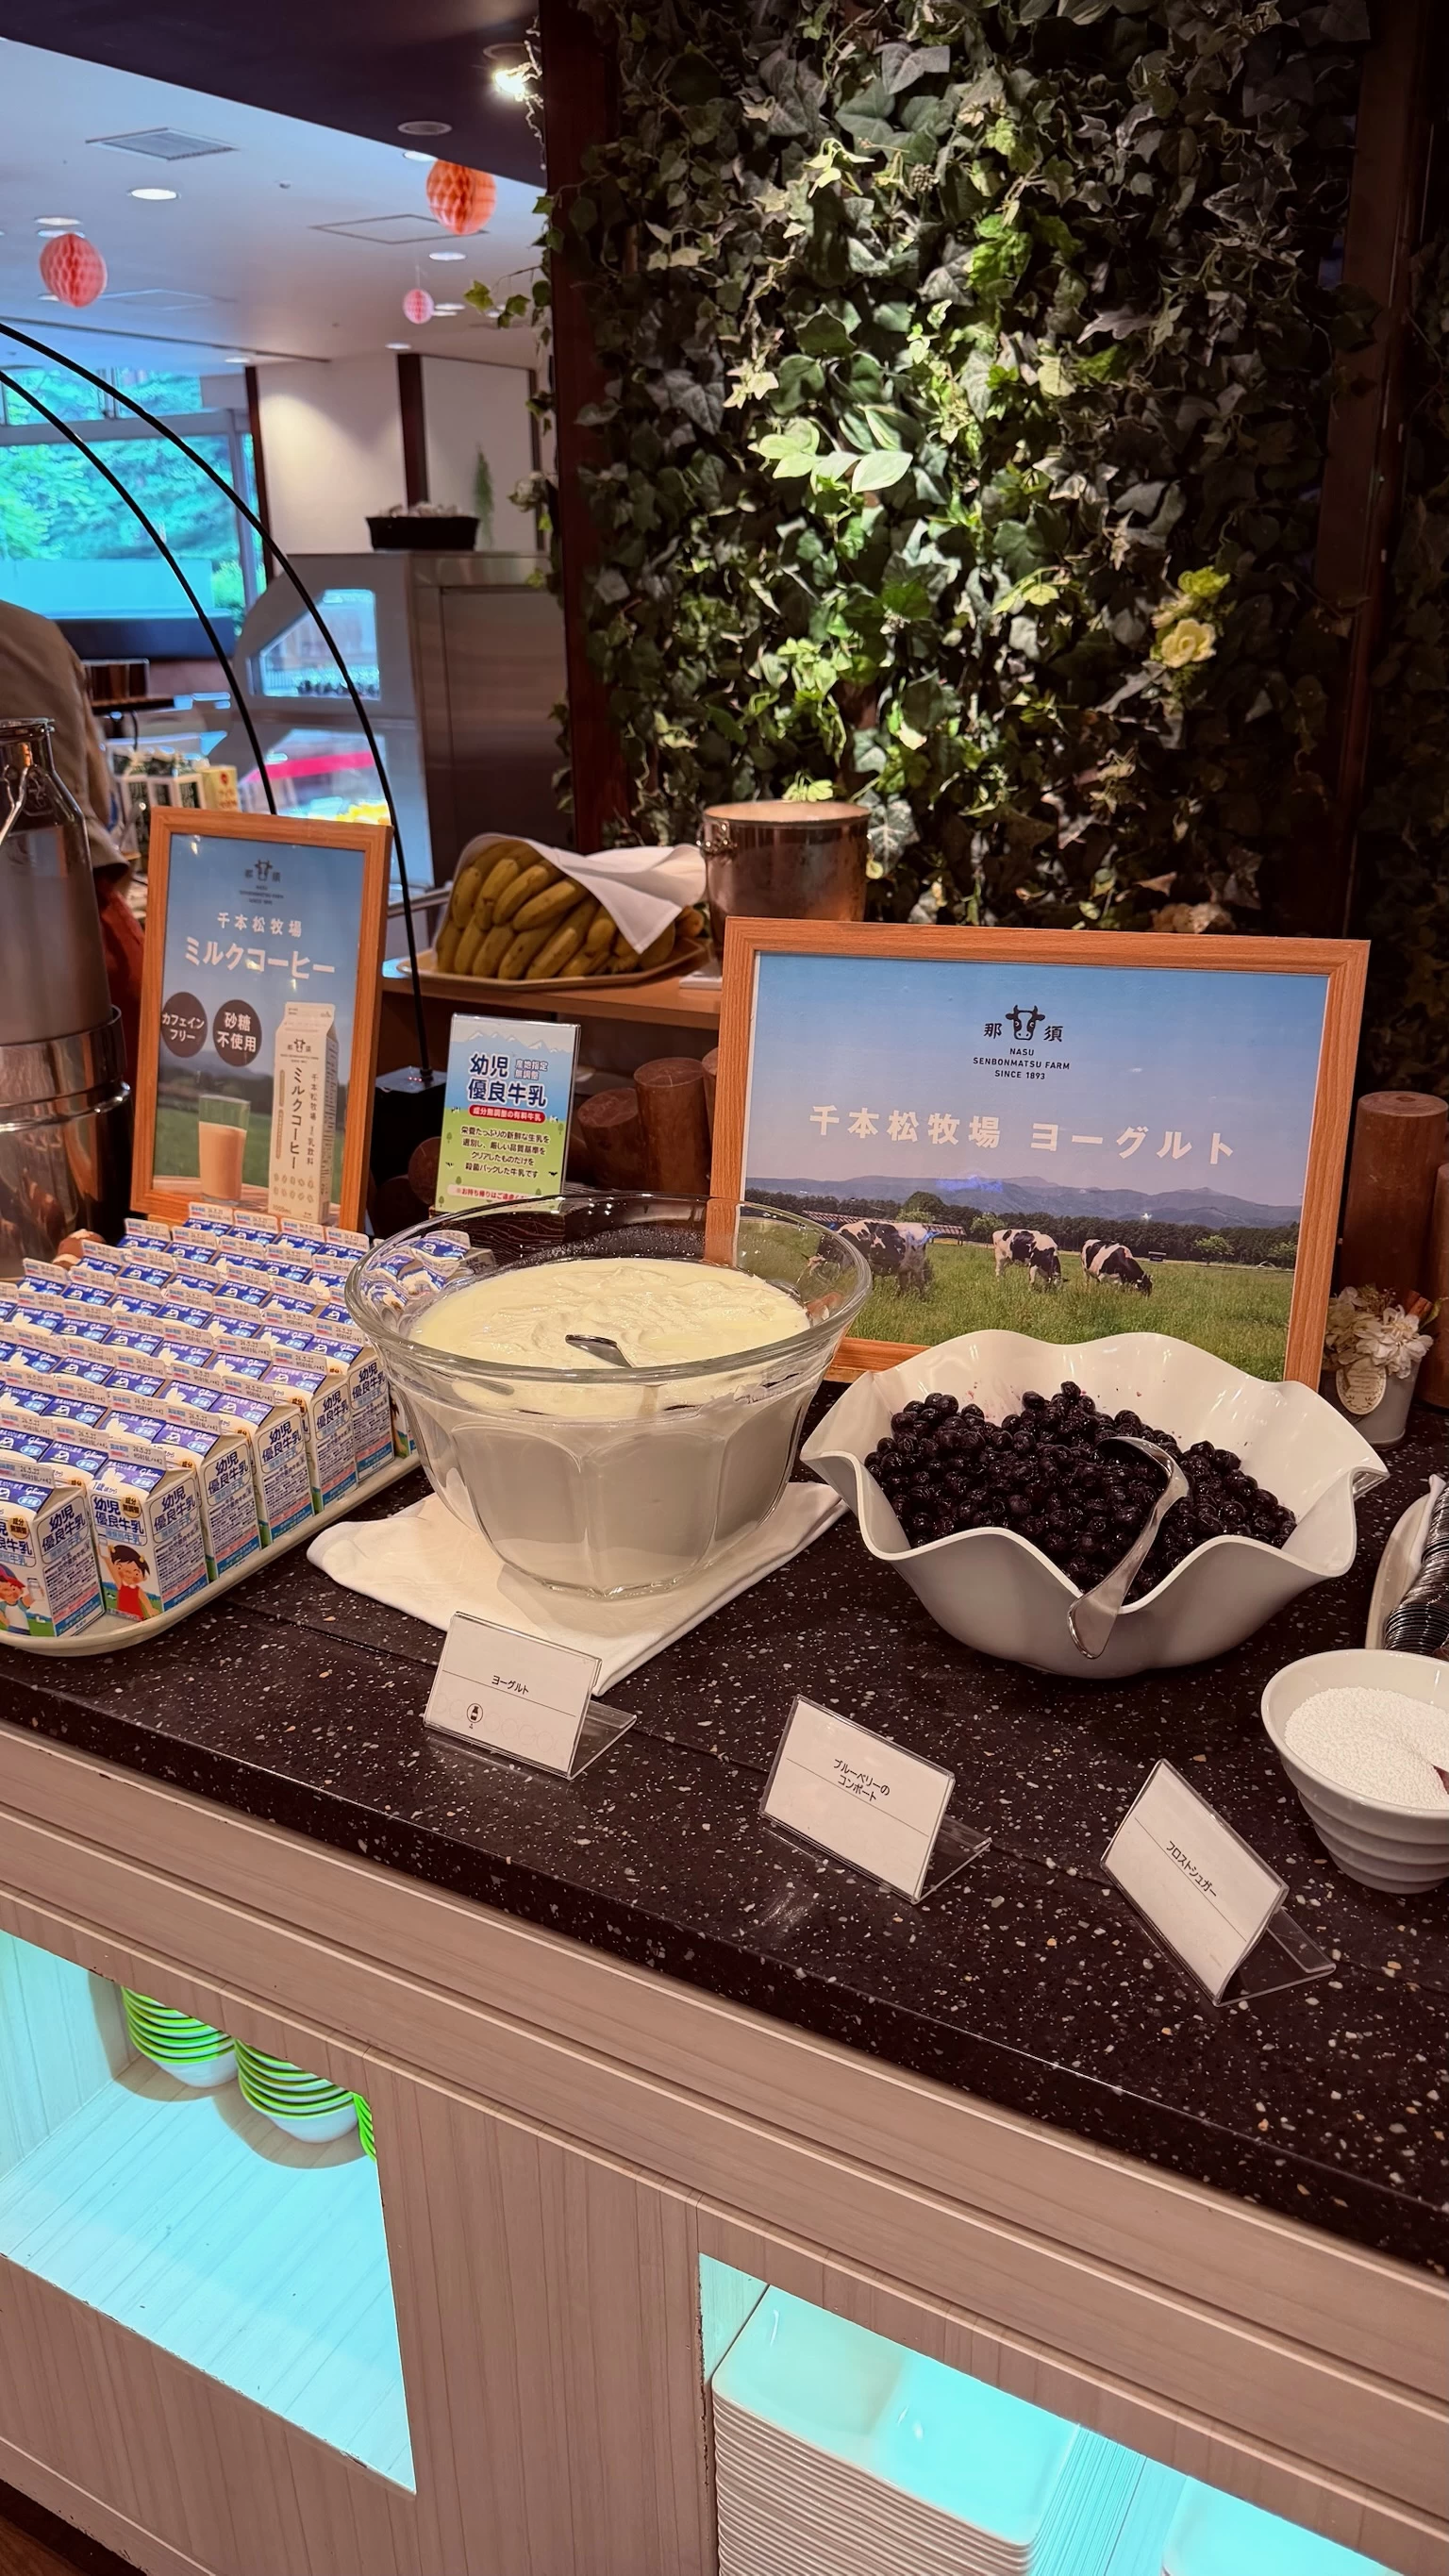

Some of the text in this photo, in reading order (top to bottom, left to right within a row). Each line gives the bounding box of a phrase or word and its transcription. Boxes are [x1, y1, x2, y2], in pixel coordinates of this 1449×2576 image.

[217, 912, 302, 938] 千本松牧場
[185, 936, 335, 979] ミルクコーヒー
[161, 1012, 205, 1029] カフェイン
[224, 1012, 251, 1032] 砂糖
[983, 1022, 1064, 1042] 那 須
[170, 1029, 196, 1042] フリー
[217, 1030, 257, 1053] 不使用
[973, 1057, 1070, 1070] SENBONMATSU FARM
[1009, 1047, 1035, 1056] NASU
[470, 1053, 508, 1078] 幼児
[994, 1069, 1022, 1079] SINCE
[468, 1079, 546, 1107] 優良牛乳
[290, 1067, 305, 1169] ミルクコーヒー
[809, 1104, 1234, 1164] 千本松牧場 ヨーグルト
[358, 1362, 378, 1383] 幼児
[316, 1398, 349, 1430] 優良牛乳
[323, 1390, 341, 1413] 幼児
[269, 1420, 292, 1445] 幼児
[261, 1432, 302, 1463] 優良牛乳
[215, 1450, 240, 1476] 幼児
[208, 1460, 249, 1496] 優良牛乳
[94, 1497, 121, 1515] 幼児
[162, 1485, 186, 1513] 幼児
[49, 1504, 75, 1531] 幼児
[95, 1512, 144, 1534] 優良牛乳
[154, 1495, 196, 1531] 優良牛乳
[42, 1513, 86, 1553] 優良牛乳
[491, 1675, 529, 1695] ヨーグルト
[833, 1758, 891, 1797] ブルーベリーの
[838, 1774, 877, 1801] コンポート
[1166, 1840, 1217, 1897] フロストシュガー
